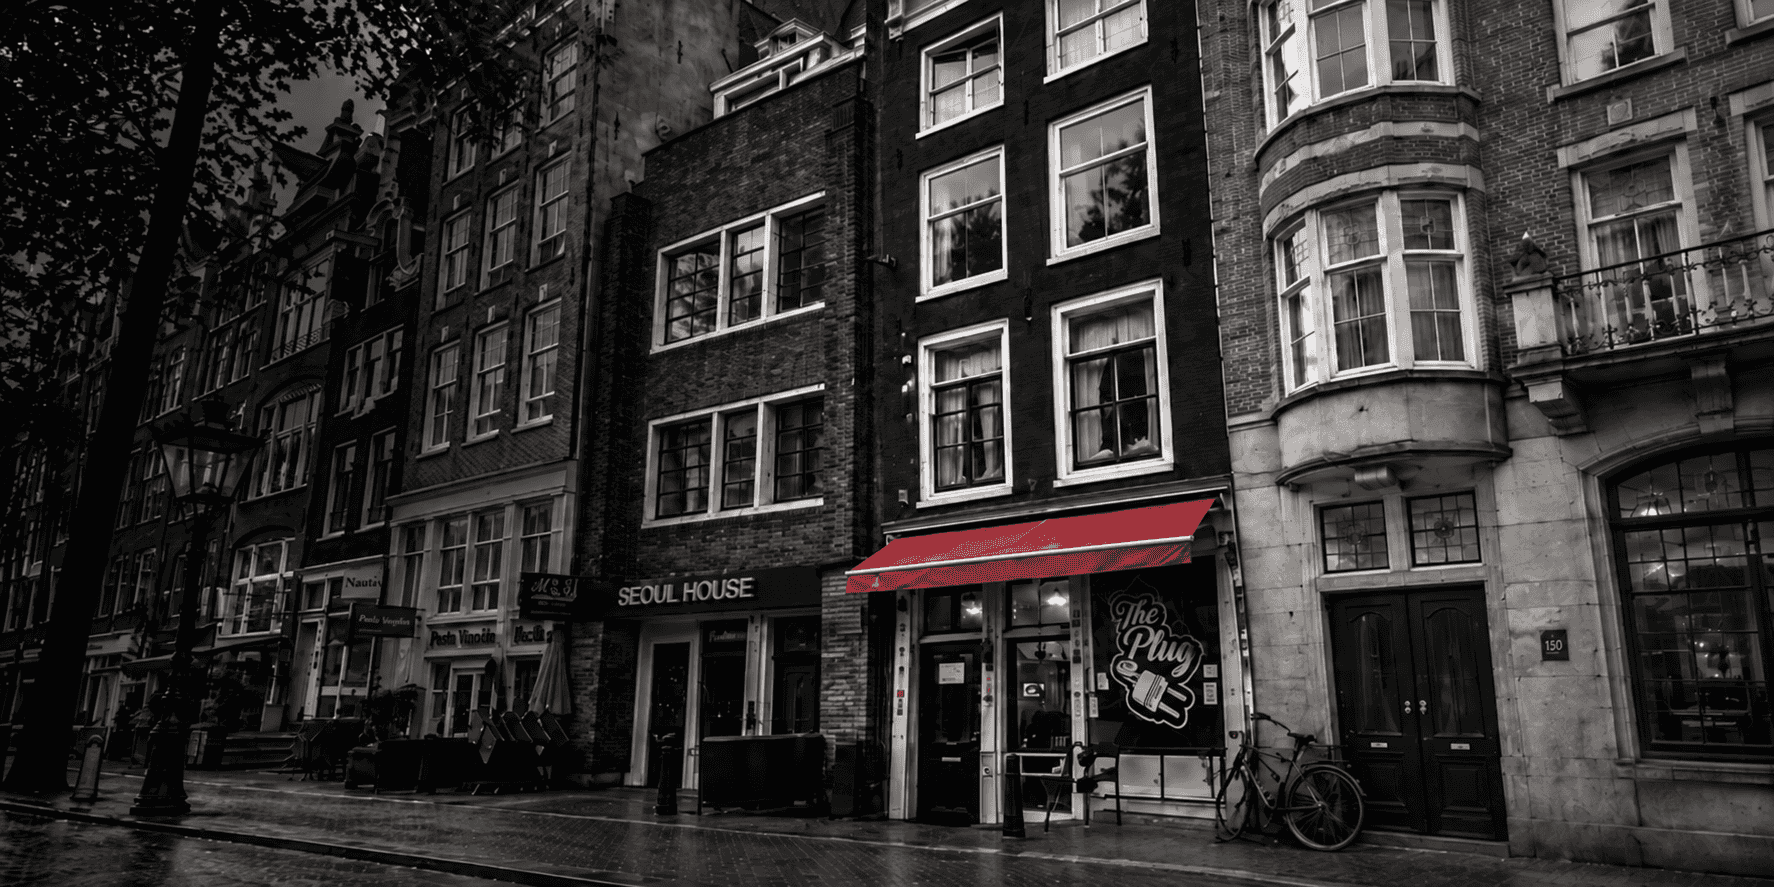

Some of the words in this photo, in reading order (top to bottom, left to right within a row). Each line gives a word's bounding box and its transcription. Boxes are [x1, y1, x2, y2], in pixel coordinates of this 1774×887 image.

[618, 584, 680, 606] SEOUL
[683, 577, 755, 602] HOUSE
[1115, 599, 1160, 630] The
[1123, 625, 1196, 678] Plug
[1545, 639, 1563, 651] 150
